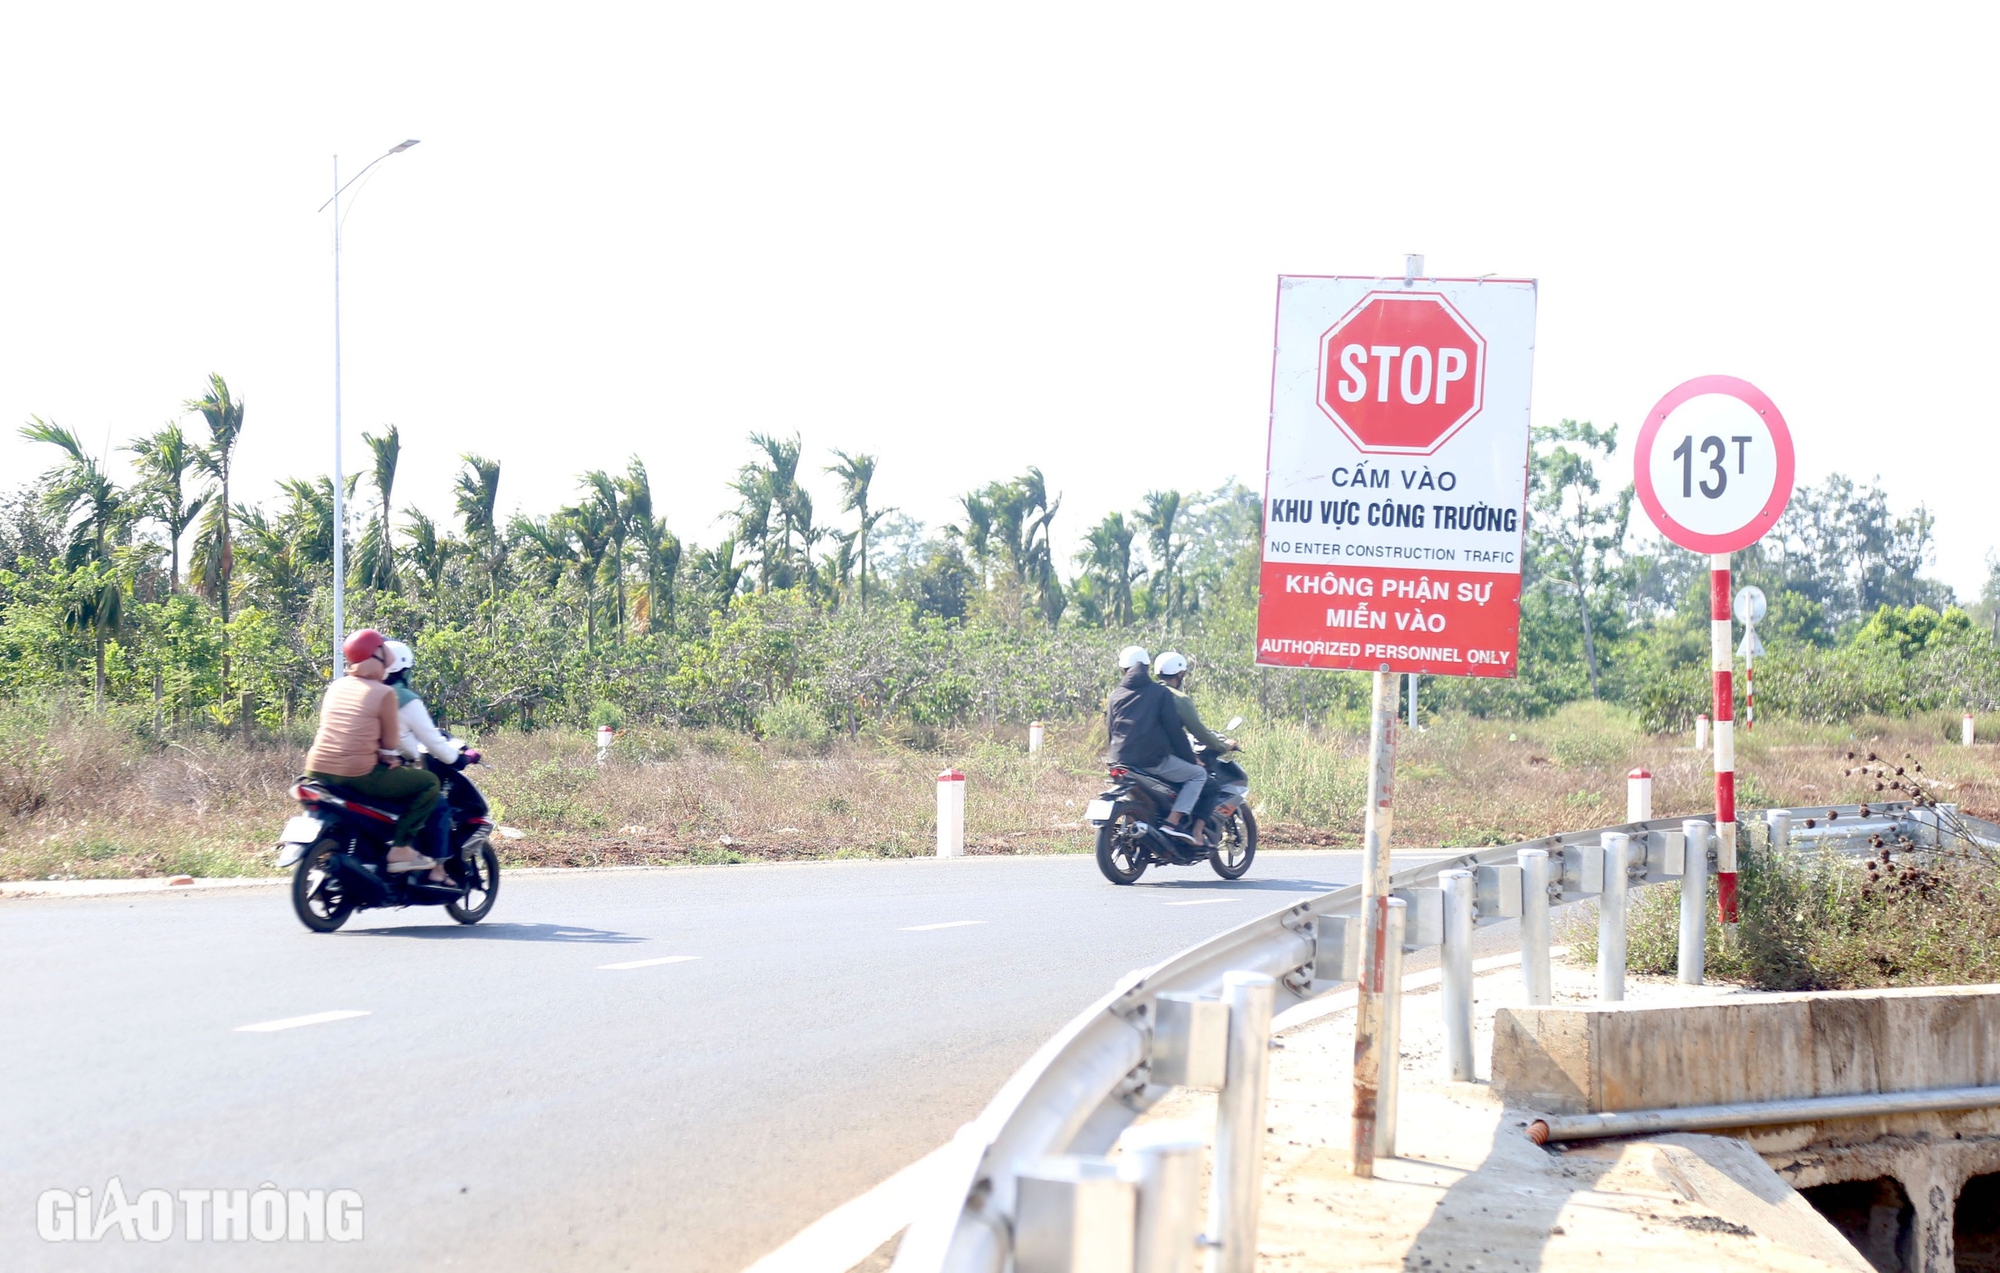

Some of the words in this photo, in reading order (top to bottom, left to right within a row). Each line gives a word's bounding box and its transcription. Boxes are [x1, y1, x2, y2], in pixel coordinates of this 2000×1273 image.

[1337, 343, 1468, 405] STOP
[1331, 460, 1390, 489] CẤM
[1400, 465, 1457, 491] VÀO
[1271, 499, 1313, 523] KHU
[1320, 499, 1360, 530] VỰC
[1367, 499, 1425, 529] CÔNG
[1433, 501, 1517, 532] TRƯỜNG
[1271, 541, 1291, 553] NO
[1295, 542, 1341, 555] ENTER
[1345, 544, 1455, 560] CONSTRUCTION
[1465, 550, 1514, 563] TRAFIC
[1285, 572, 1373, 597] KHÔNG
[1382, 576, 1449, 603] PHẬN
[1457, 581, 1493, 606] SỰ
[1326, 602, 1386, 630] MIỄN
[1394, 608, 1446, 632] VÀO
[1261, 638, 1361, 657] AUTHORIZED
[1364, 643, 1462, 663] PERSONNEL
[1467, 649, 1510, 665] ONLY
